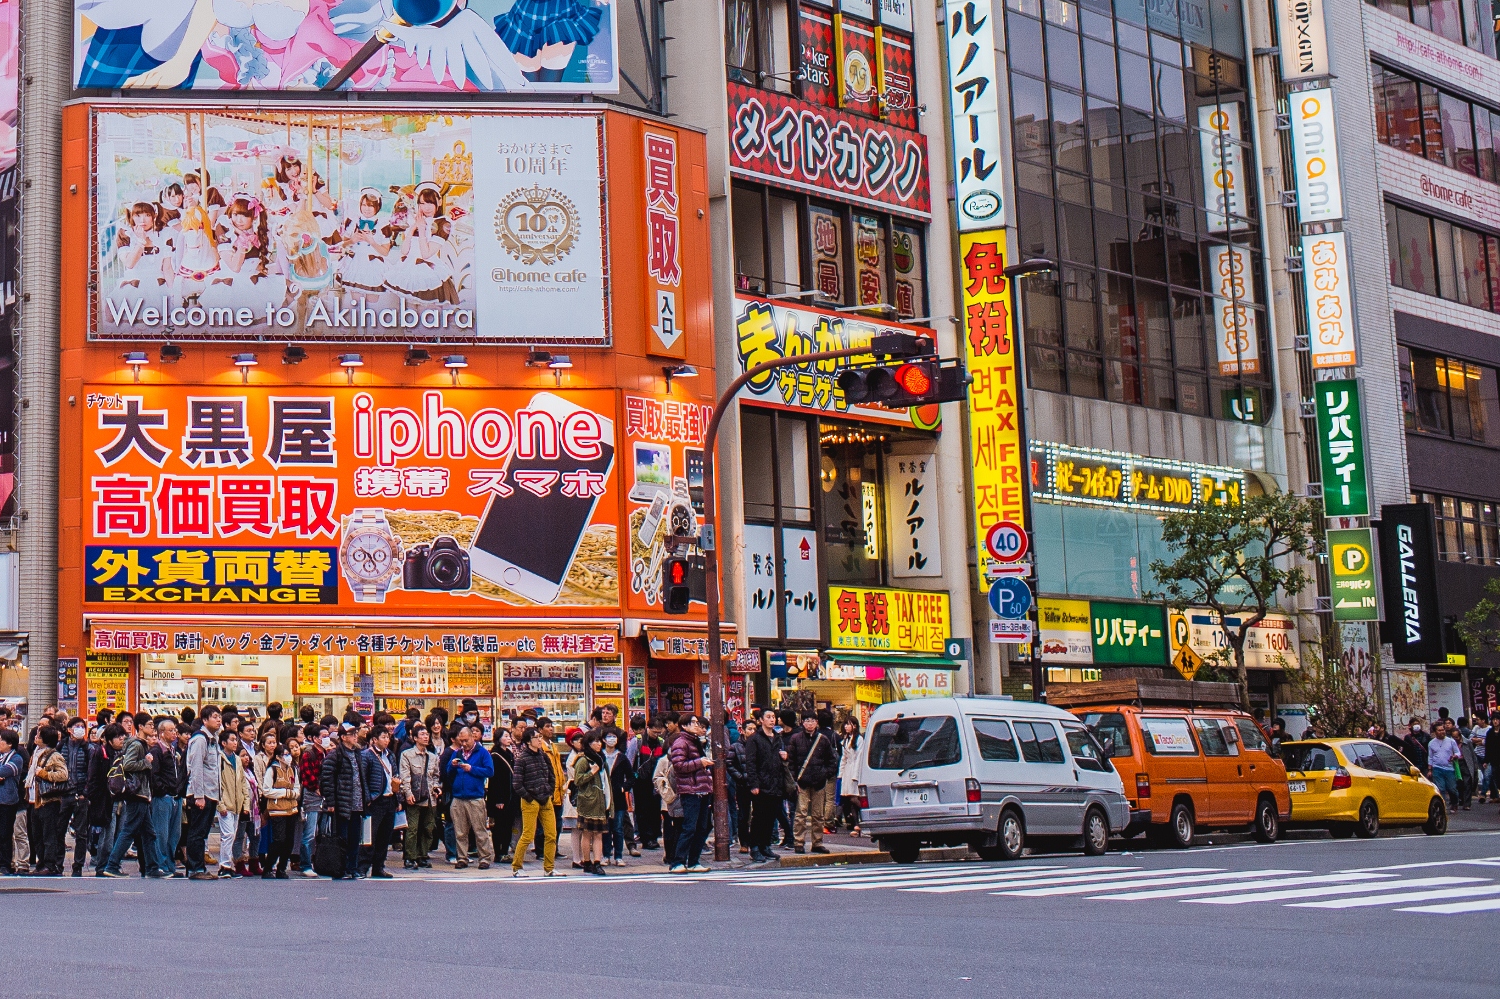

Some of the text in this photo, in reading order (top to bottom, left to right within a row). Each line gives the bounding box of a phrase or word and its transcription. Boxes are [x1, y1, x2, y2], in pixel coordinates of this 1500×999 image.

[949, 2, 999, 185] ルノアール
[497, 142, 574, 155] おかげさまで
[504, 155, 569, 176] 10周年
[732, 96, 922, 203] メイドカジノ
[1300, 96, 1332, 217] amiami
[1419, 173, 1473, 209] @home cafe
[644, 133, 682, 288] 買取
[491, 267, 587, 283] @home cafe
[963, 241, 1011, 357] 免税
[1312, 239, 1344, 346] あみあみ
[104, 296, 475, 329] Welcome to Akihabara
[659, 296, 675, 335] 入口
[86, 392, 123, 409] チケット
[96, 396, 338, 470] 大黒屋
[353, 391, 603, 466] iphone
[994, 367, 1021, 527] TAX FREE
[1326, 389, 1355, 507] リバティー
[355, 468, 607, 499] 携帯 スマホ
[898, 460, 927, 475] 喫茶室
[94, 475, 339, 541] 高価買取
[905, 477, 928, 571] ルノアール
[864, 498, 876, 557] ルノアール
[995, 532, 1019, 552] 40
[92, 548, 332, 587] 外貨両替
[1347, 549, 1362, 570] P
[103, 587, 321, 603] EXCHANGE
[1396, 523, 1422, 645] GALLERIA
[837, 589, 942, 636] 免税 TAX FREE
[999, 588, 1022, 615] P 60
[1043, 611, 1061, 623] Yellow
[1362, 596, 1376, 608] IN
[93, 630, 616, 653] 高価買取 無料査定
[897, 624, 945, 651] 면세점
[1094, 617, 1162, 647] リバティー
[151, 670, 175, 679] iPhone
[897, 672, 949, 689] 比价店
